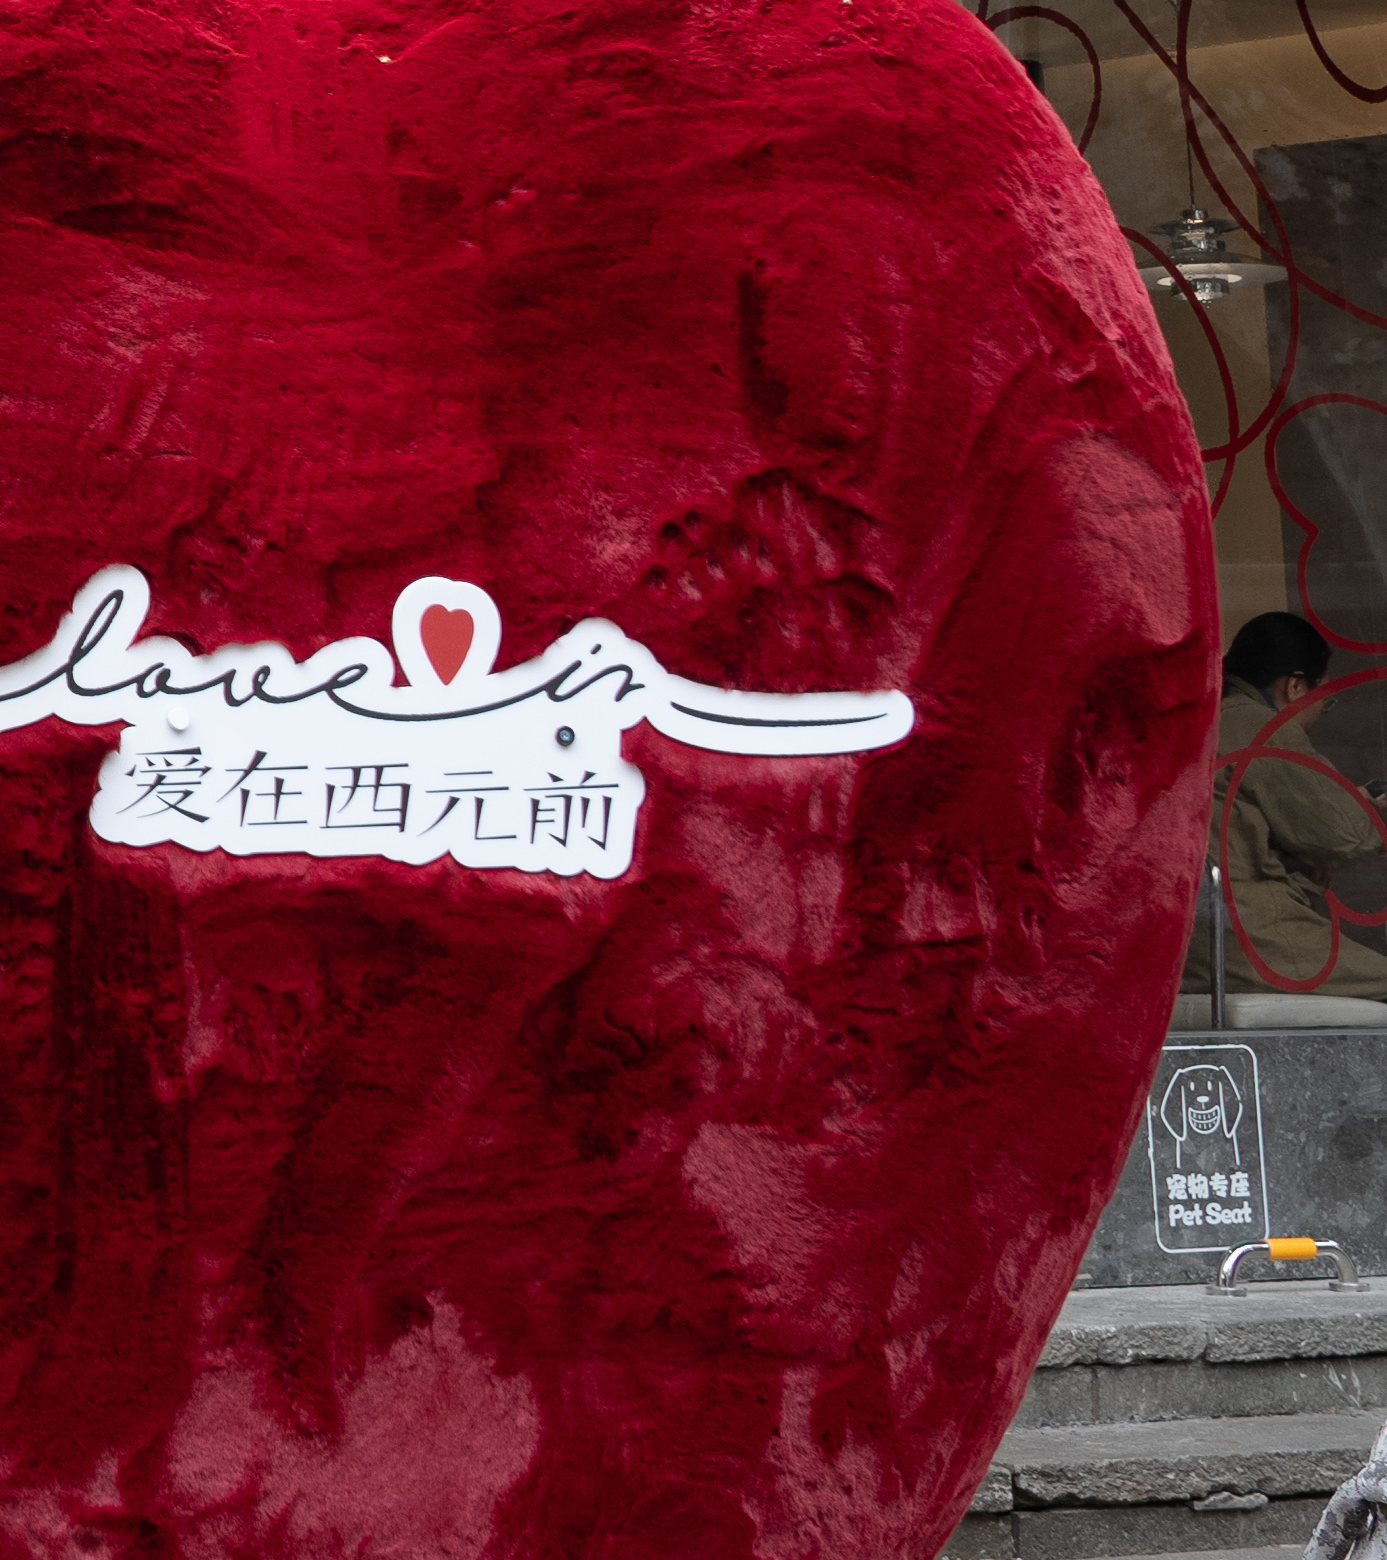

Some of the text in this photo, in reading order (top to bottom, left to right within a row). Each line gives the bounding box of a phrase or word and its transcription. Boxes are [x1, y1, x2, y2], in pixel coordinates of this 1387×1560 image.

[114, 746, 622, 851] 爱在西元前
[1165, 1171, 1251, 1200] 宠物专座
[1168, 1200, 1253, 1227] Pet Seat
